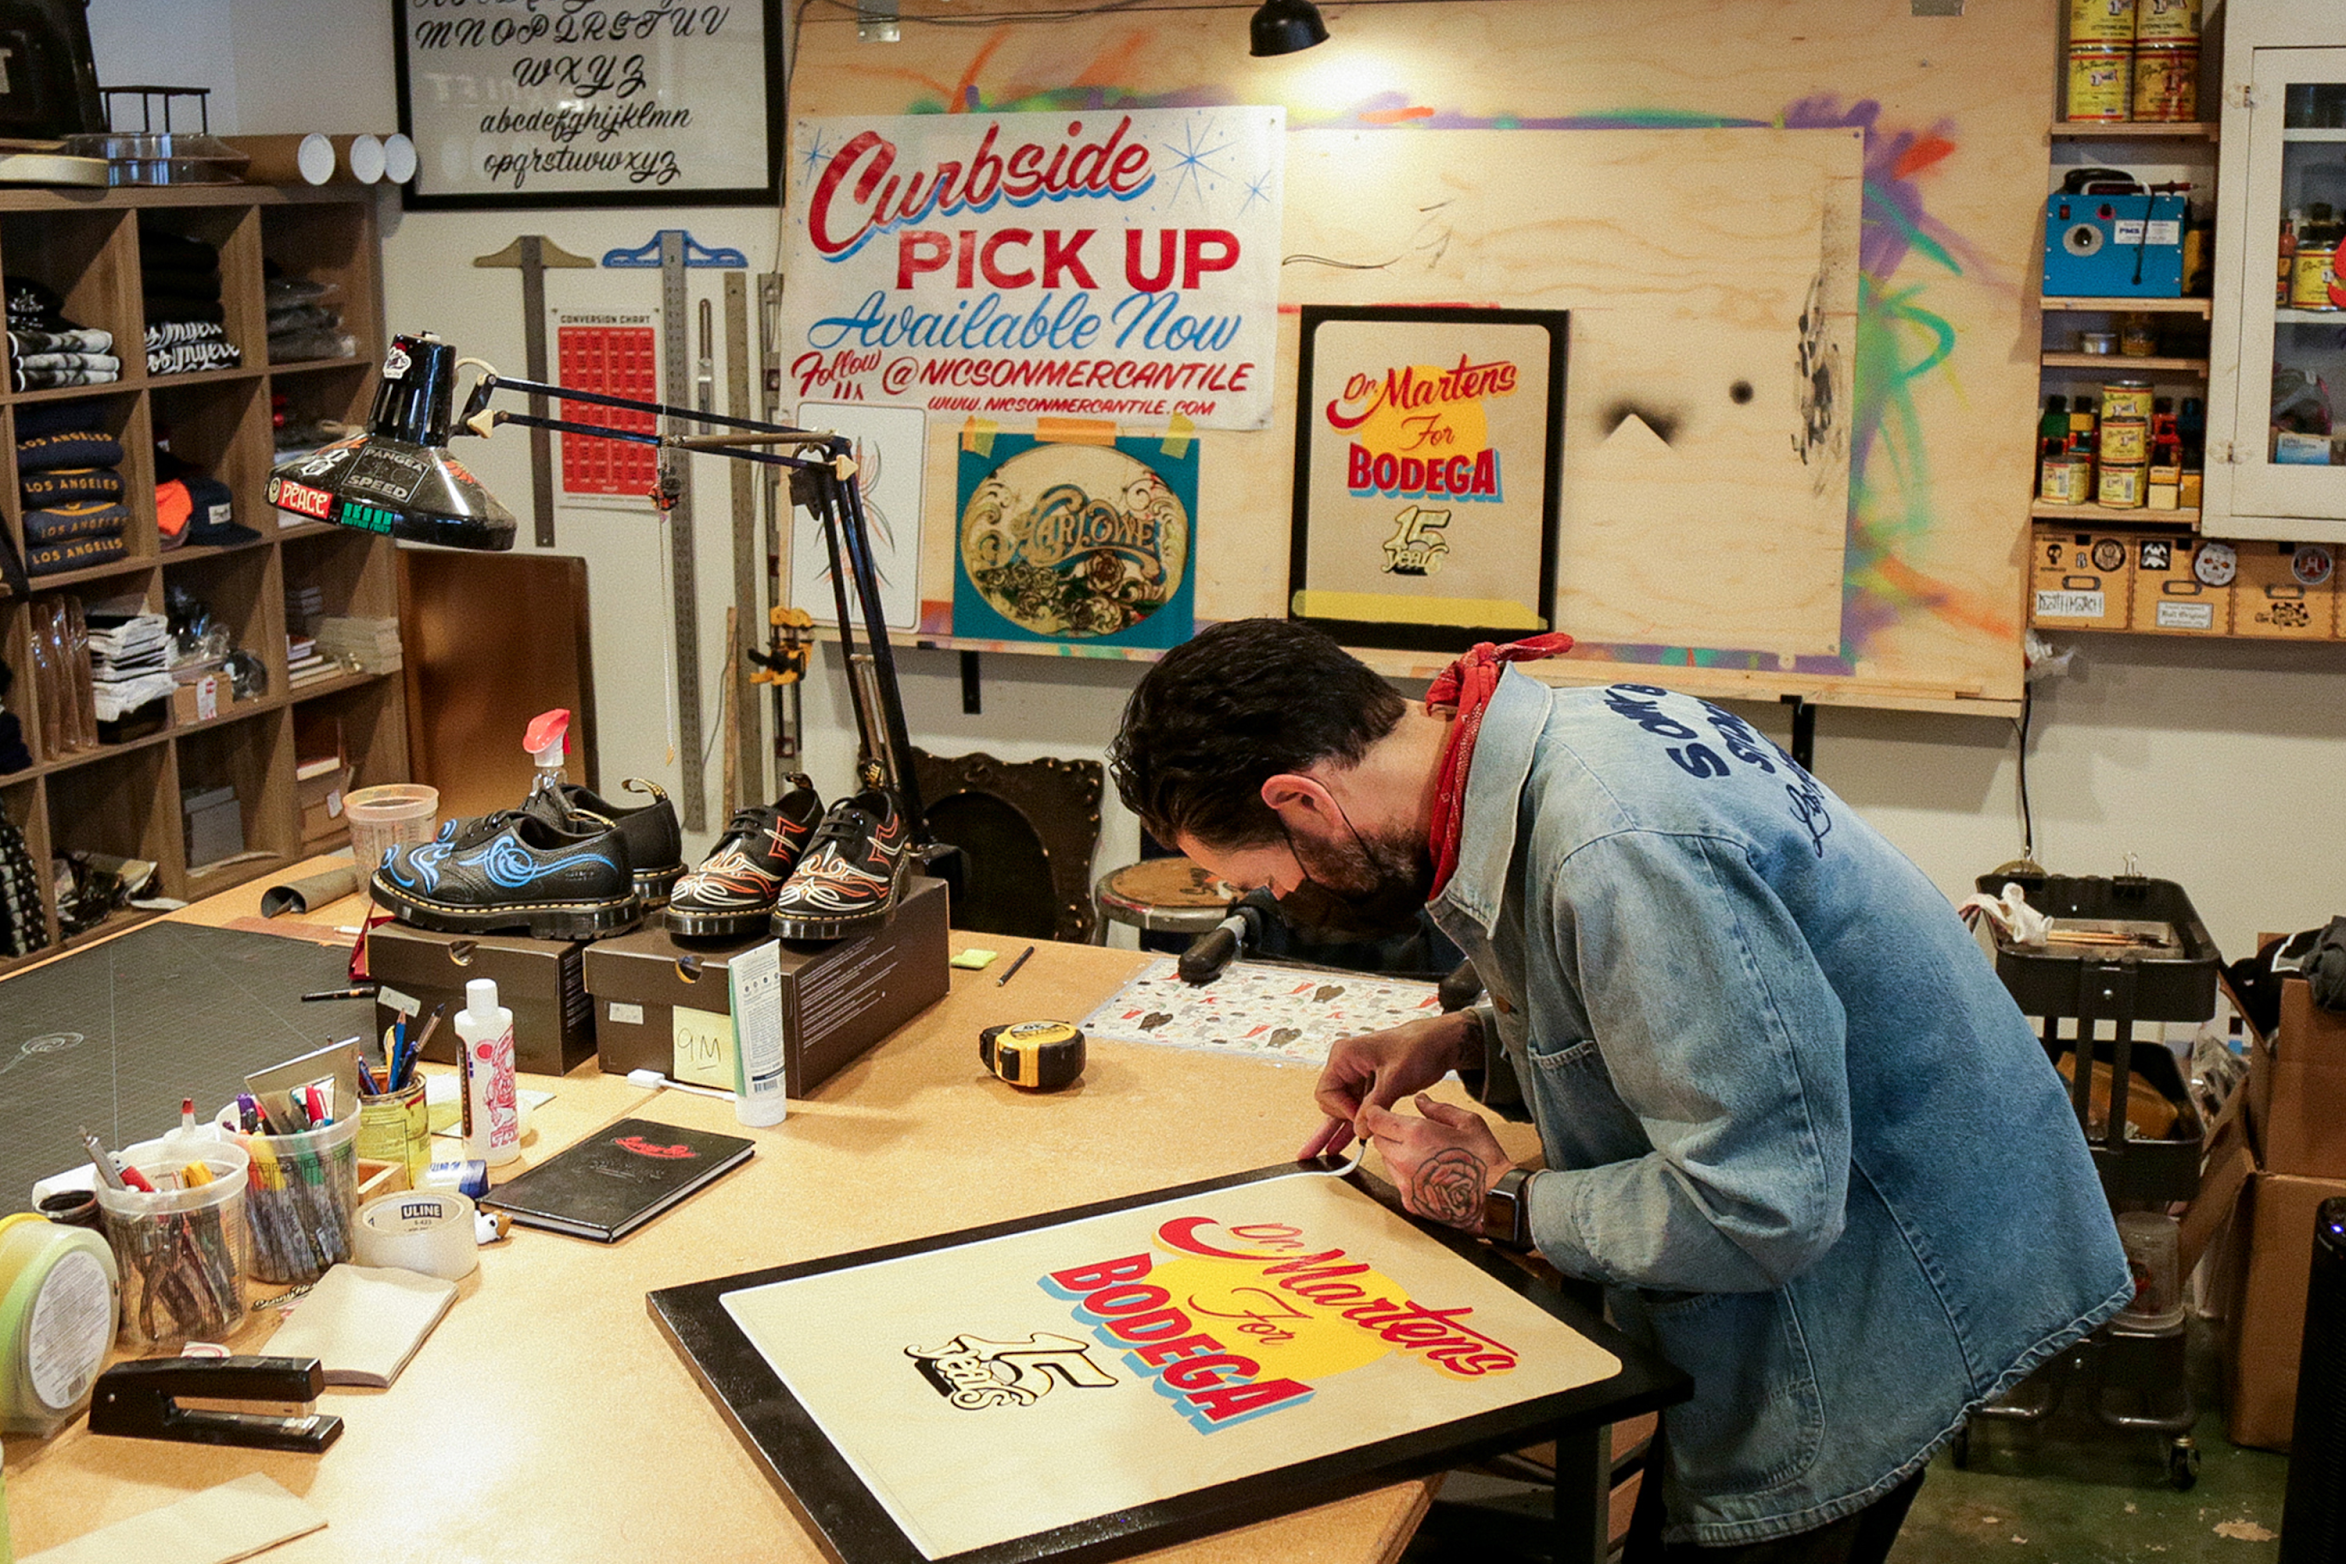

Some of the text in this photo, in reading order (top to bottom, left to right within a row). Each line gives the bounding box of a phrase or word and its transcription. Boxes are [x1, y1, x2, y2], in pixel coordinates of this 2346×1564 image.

[480, 101, 693, 142] abcdefghijklmn
[484, 145, 681, 189] opqrstuvwxyz
[808, 114, 1155, 262] Curbside
[896, 228, 1241, 293] PICK UP
[560, 314, 651, 324] CONVERSION CHART
[808, 289, 1242, 352] Available Now
[791, 349, 882, 398] Follow
[881, 355, 1255, 394] @NICSONMERCANTILE
[1326, 353, 1518, 430] Martens
[51, 431, 113, 444] ANGELES
[1398, 413, 1456, 451] For
[364, 448, 426, 472] PANGEA
[1347, 441, 1503, 503] BODEGA
[25, 477, 119, 493] LOS ANGELES
[348, 475, 408, 499] SPEED
[1383, 504, 1452, 553] 15
[32, 537, 124, 565] LOS ANGELES
[403, 1205, 441, 1218] ULINE
[1158, 1215, 1521, 1378] Martens
[1189, 1287, 1314, 1346] For
[1036, 1251, 1316, 1437] BODEGA
